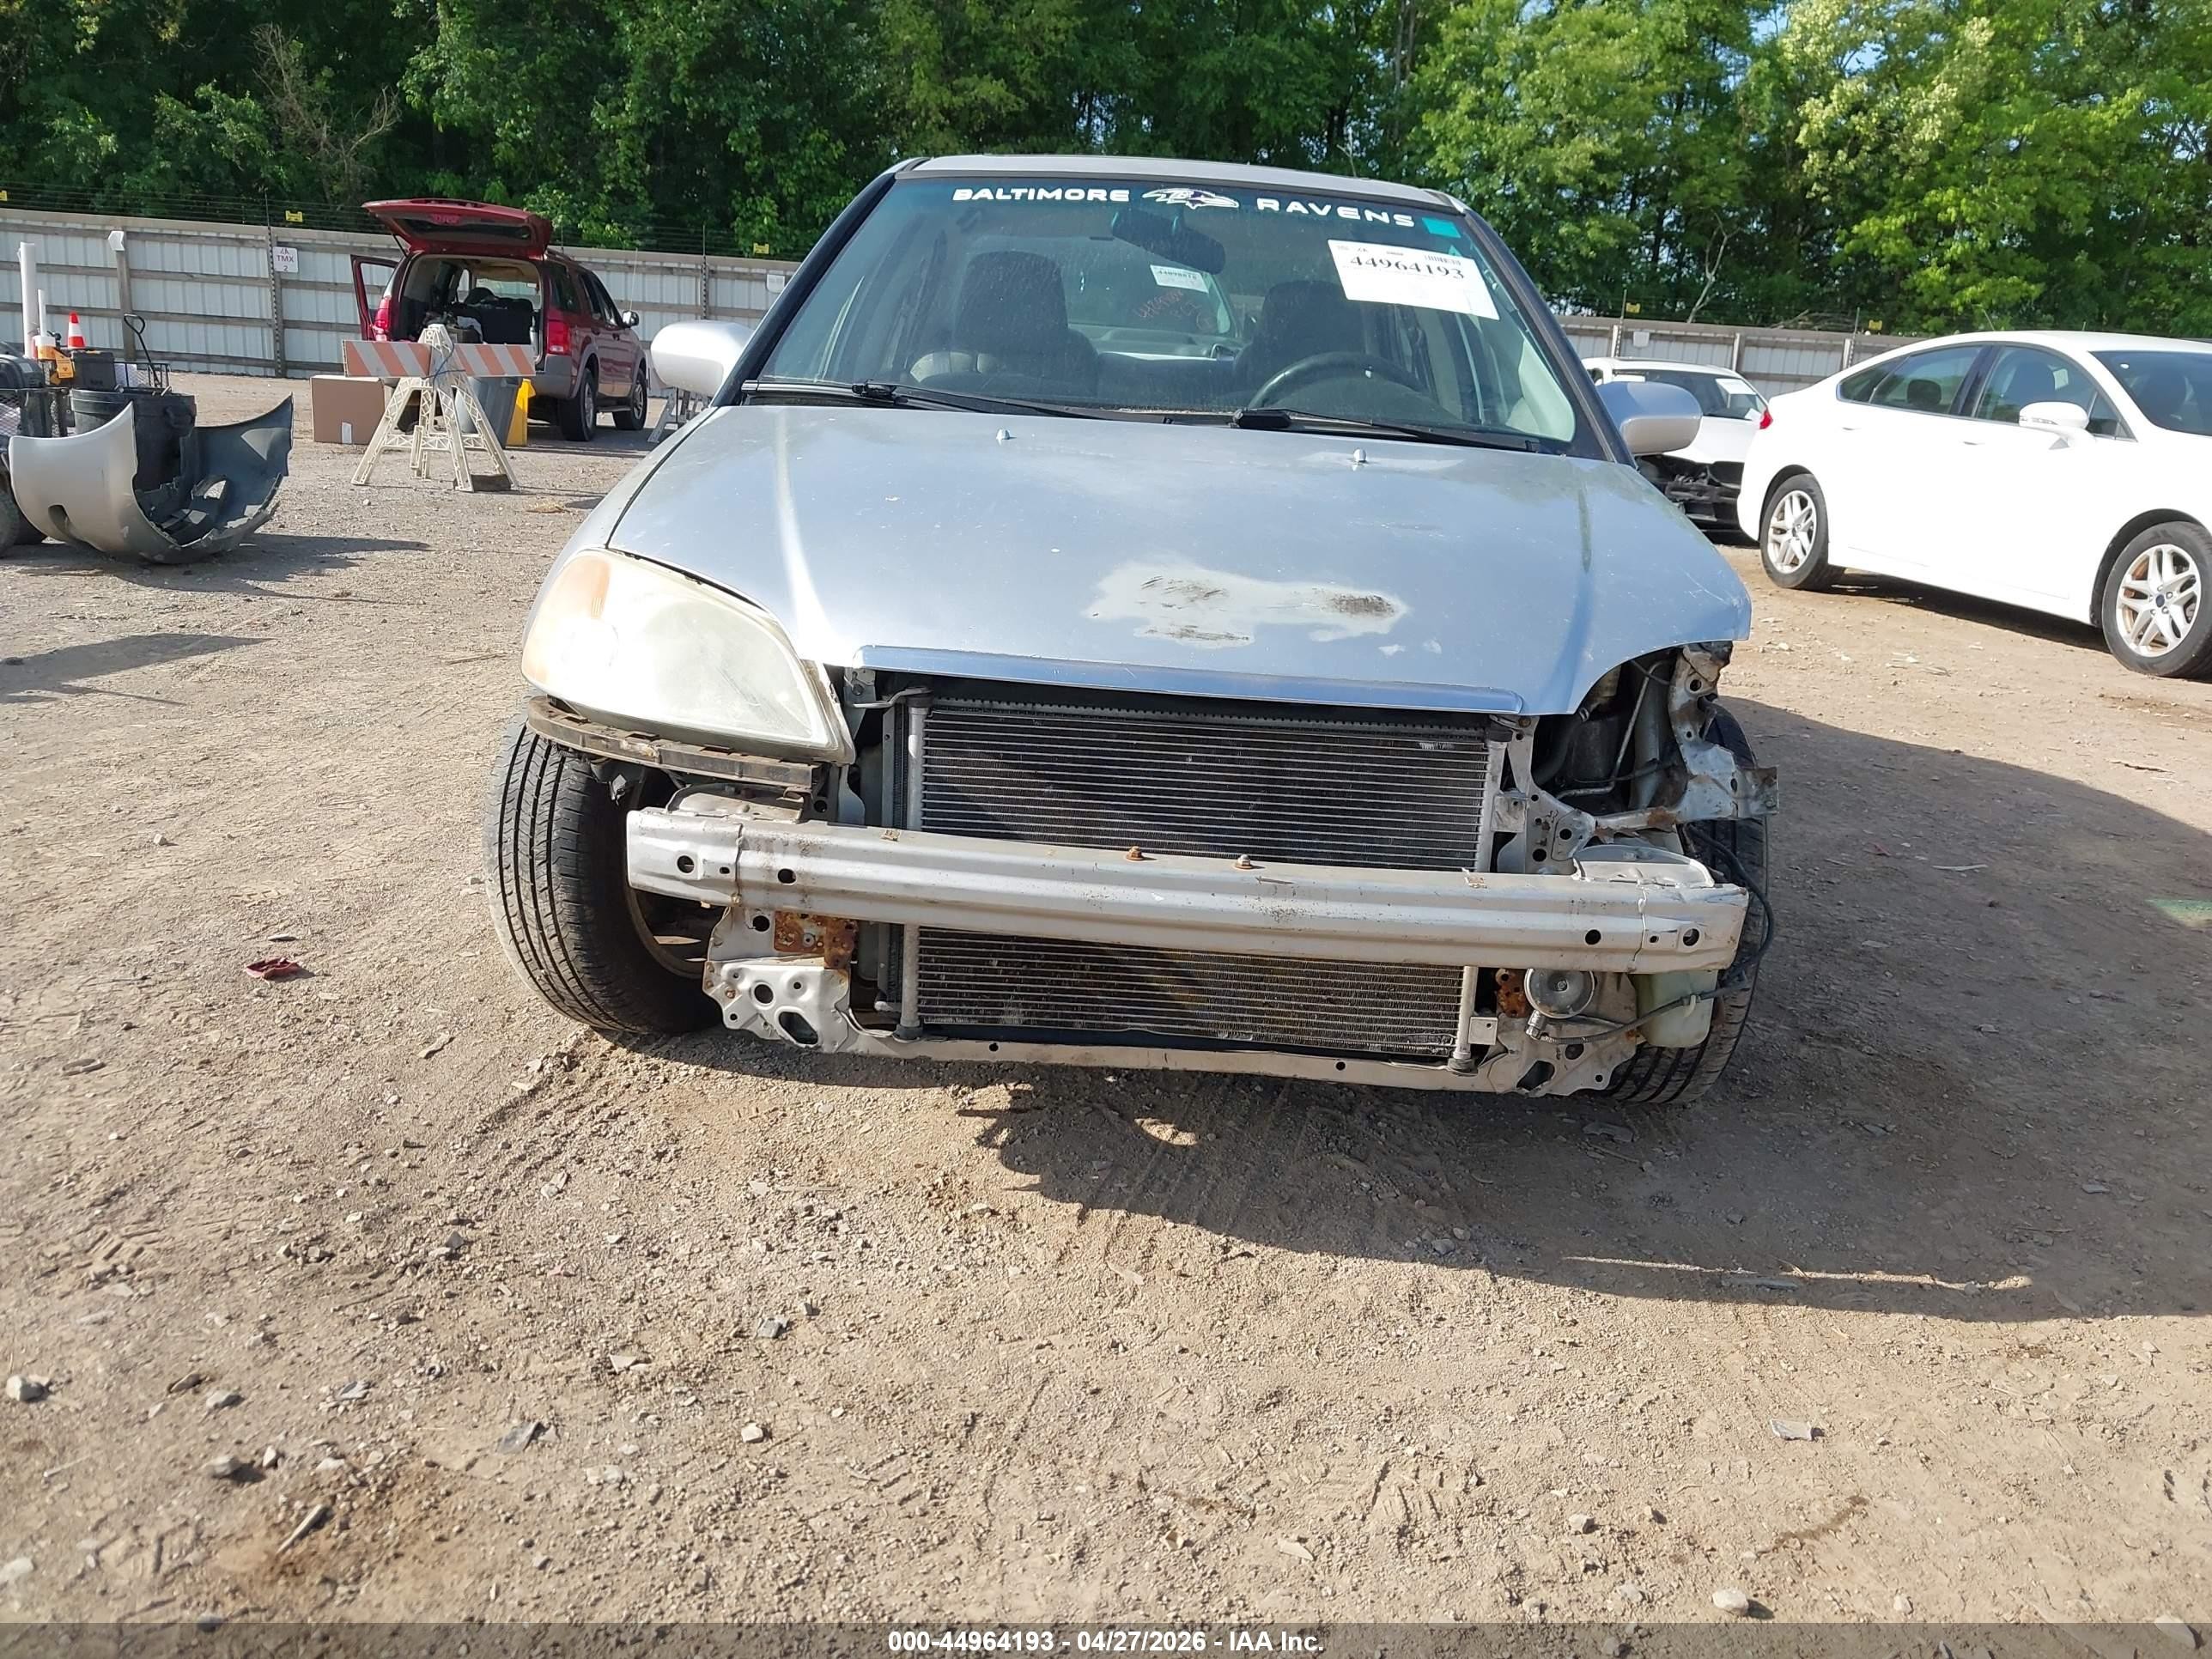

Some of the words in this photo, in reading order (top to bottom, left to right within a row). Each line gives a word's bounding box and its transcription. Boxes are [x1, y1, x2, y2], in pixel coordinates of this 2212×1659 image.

[952, 187, 1130, 203] BALTIMORE
[1256, 198, 1414, 227] RAVENS
[276, 254, 295, 263] TMX
[1351, 255, 1464, 280] 44964193
